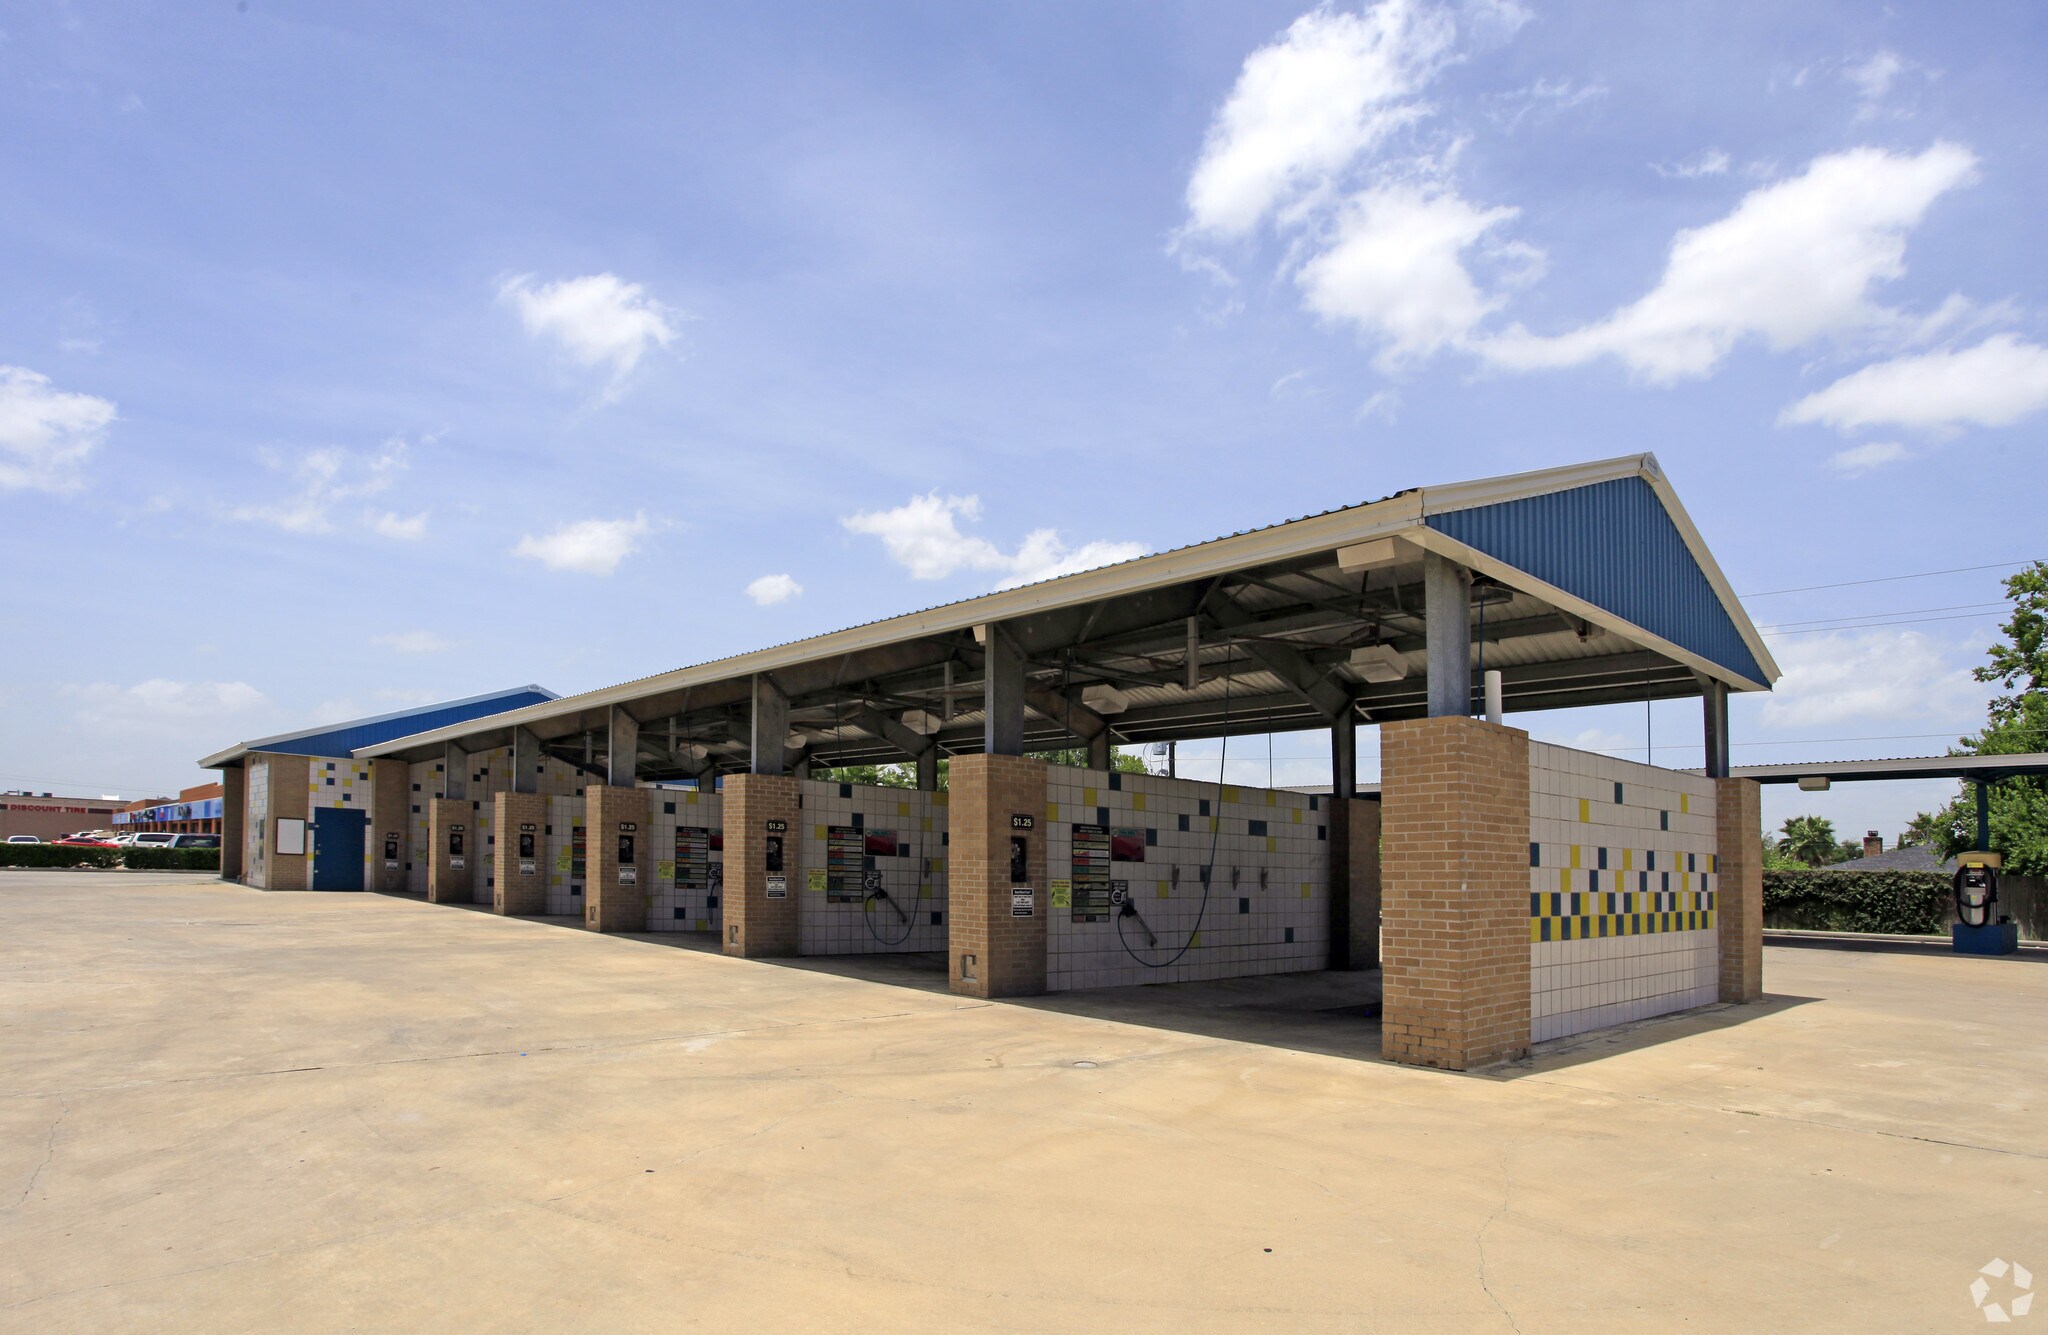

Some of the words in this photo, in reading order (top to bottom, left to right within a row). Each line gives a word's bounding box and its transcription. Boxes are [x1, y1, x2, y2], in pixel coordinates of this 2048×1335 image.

[10, 804, 62, 812] DISCOUNT
[64, 806, 86, 814] TIRE
[1013, 817, 1032, 827] $1.25
